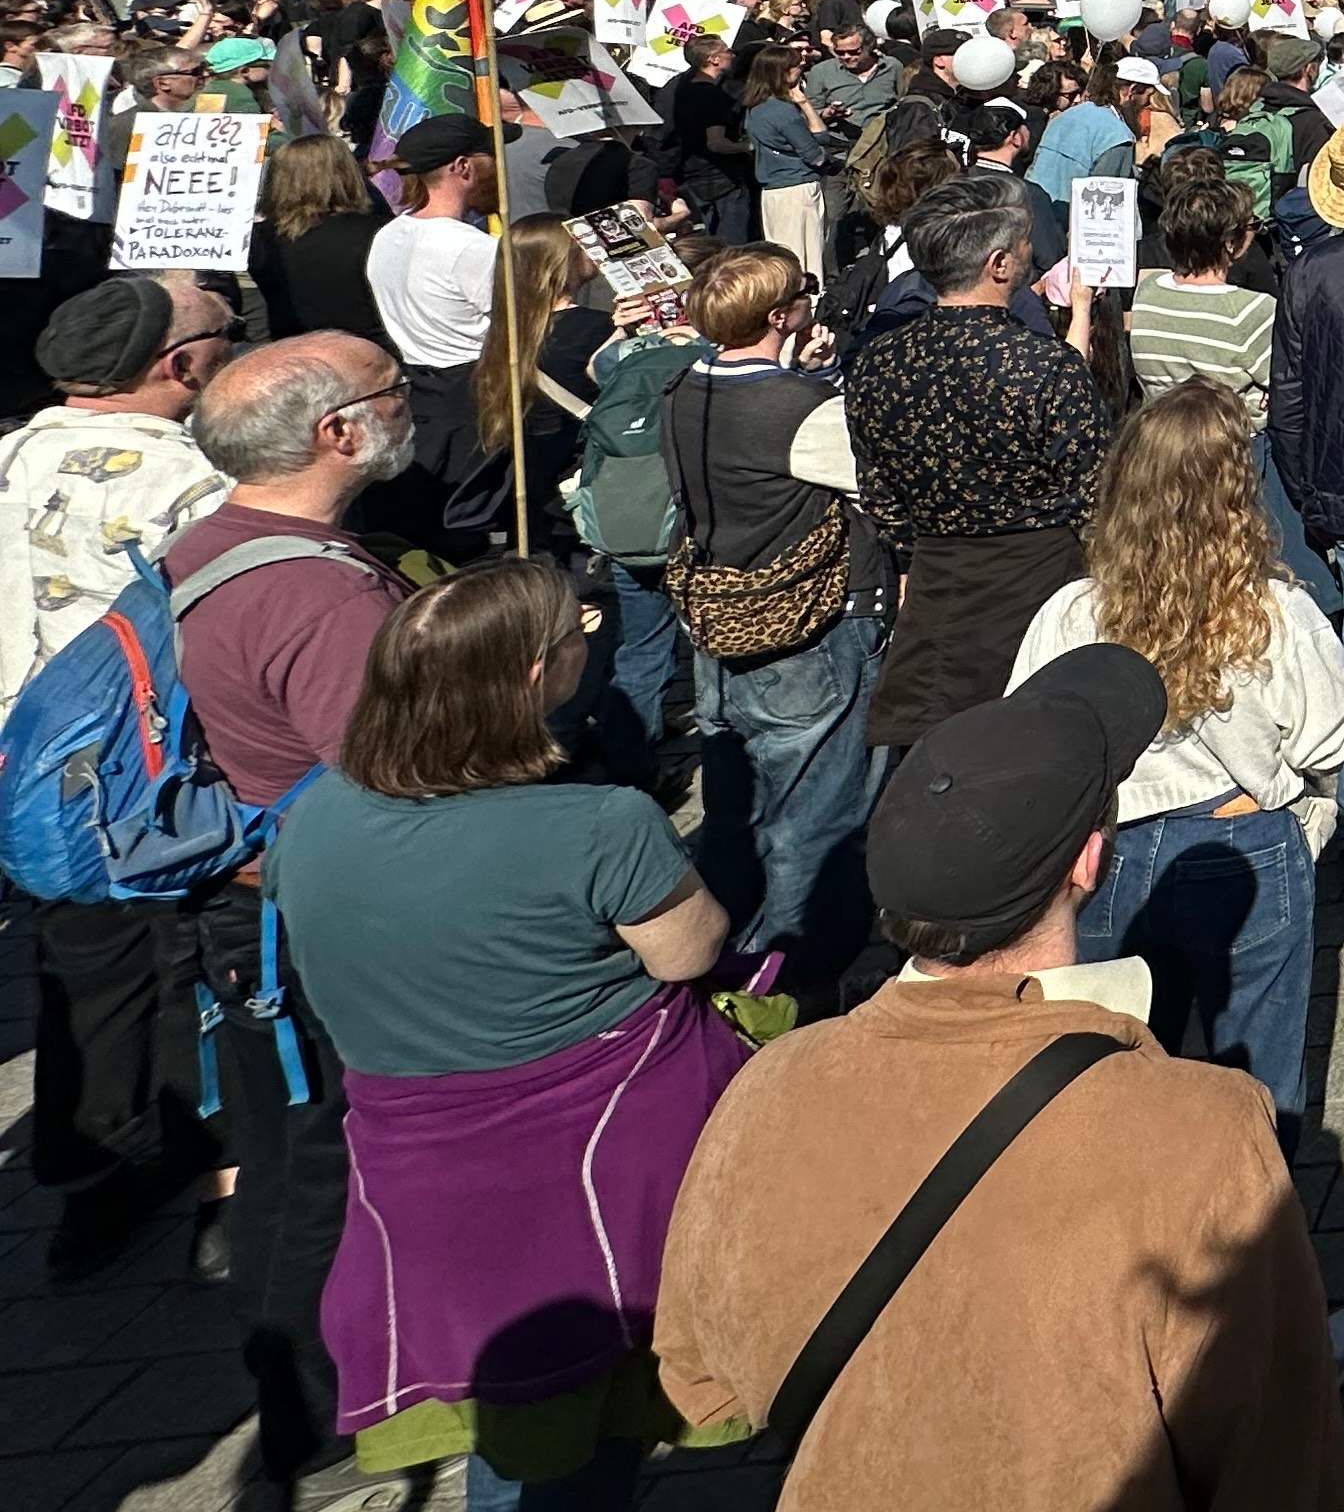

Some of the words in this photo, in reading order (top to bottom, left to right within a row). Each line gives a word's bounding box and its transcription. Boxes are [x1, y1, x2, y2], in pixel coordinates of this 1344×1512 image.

[678, 22, 706, 33] AFD
[155, 116, 200, 150] afd
[144, 166, 238, 197] NEEE!
[143, 225, 228, 239] TOLERANZ-
[129, 241, 225, 260] PARADOXON
